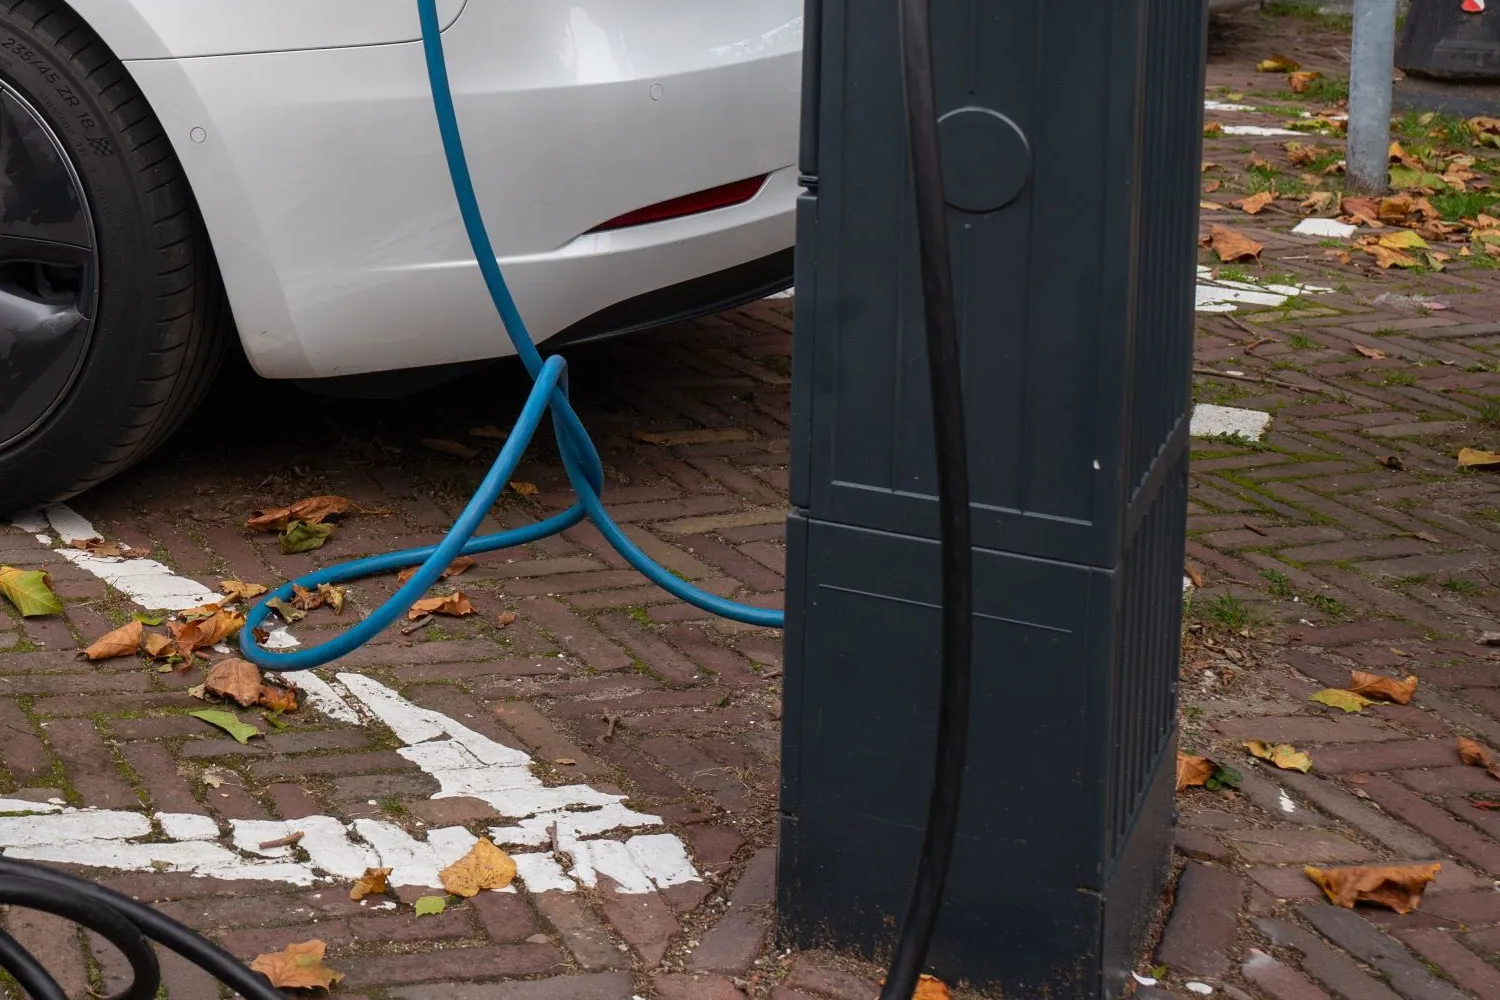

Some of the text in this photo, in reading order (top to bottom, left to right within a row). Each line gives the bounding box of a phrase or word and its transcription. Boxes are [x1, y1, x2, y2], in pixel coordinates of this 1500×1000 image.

[1, 38, 60, 84] 235/45
[56, 85, 80, 108] ZR
[77, 112, 95, 130] 18
